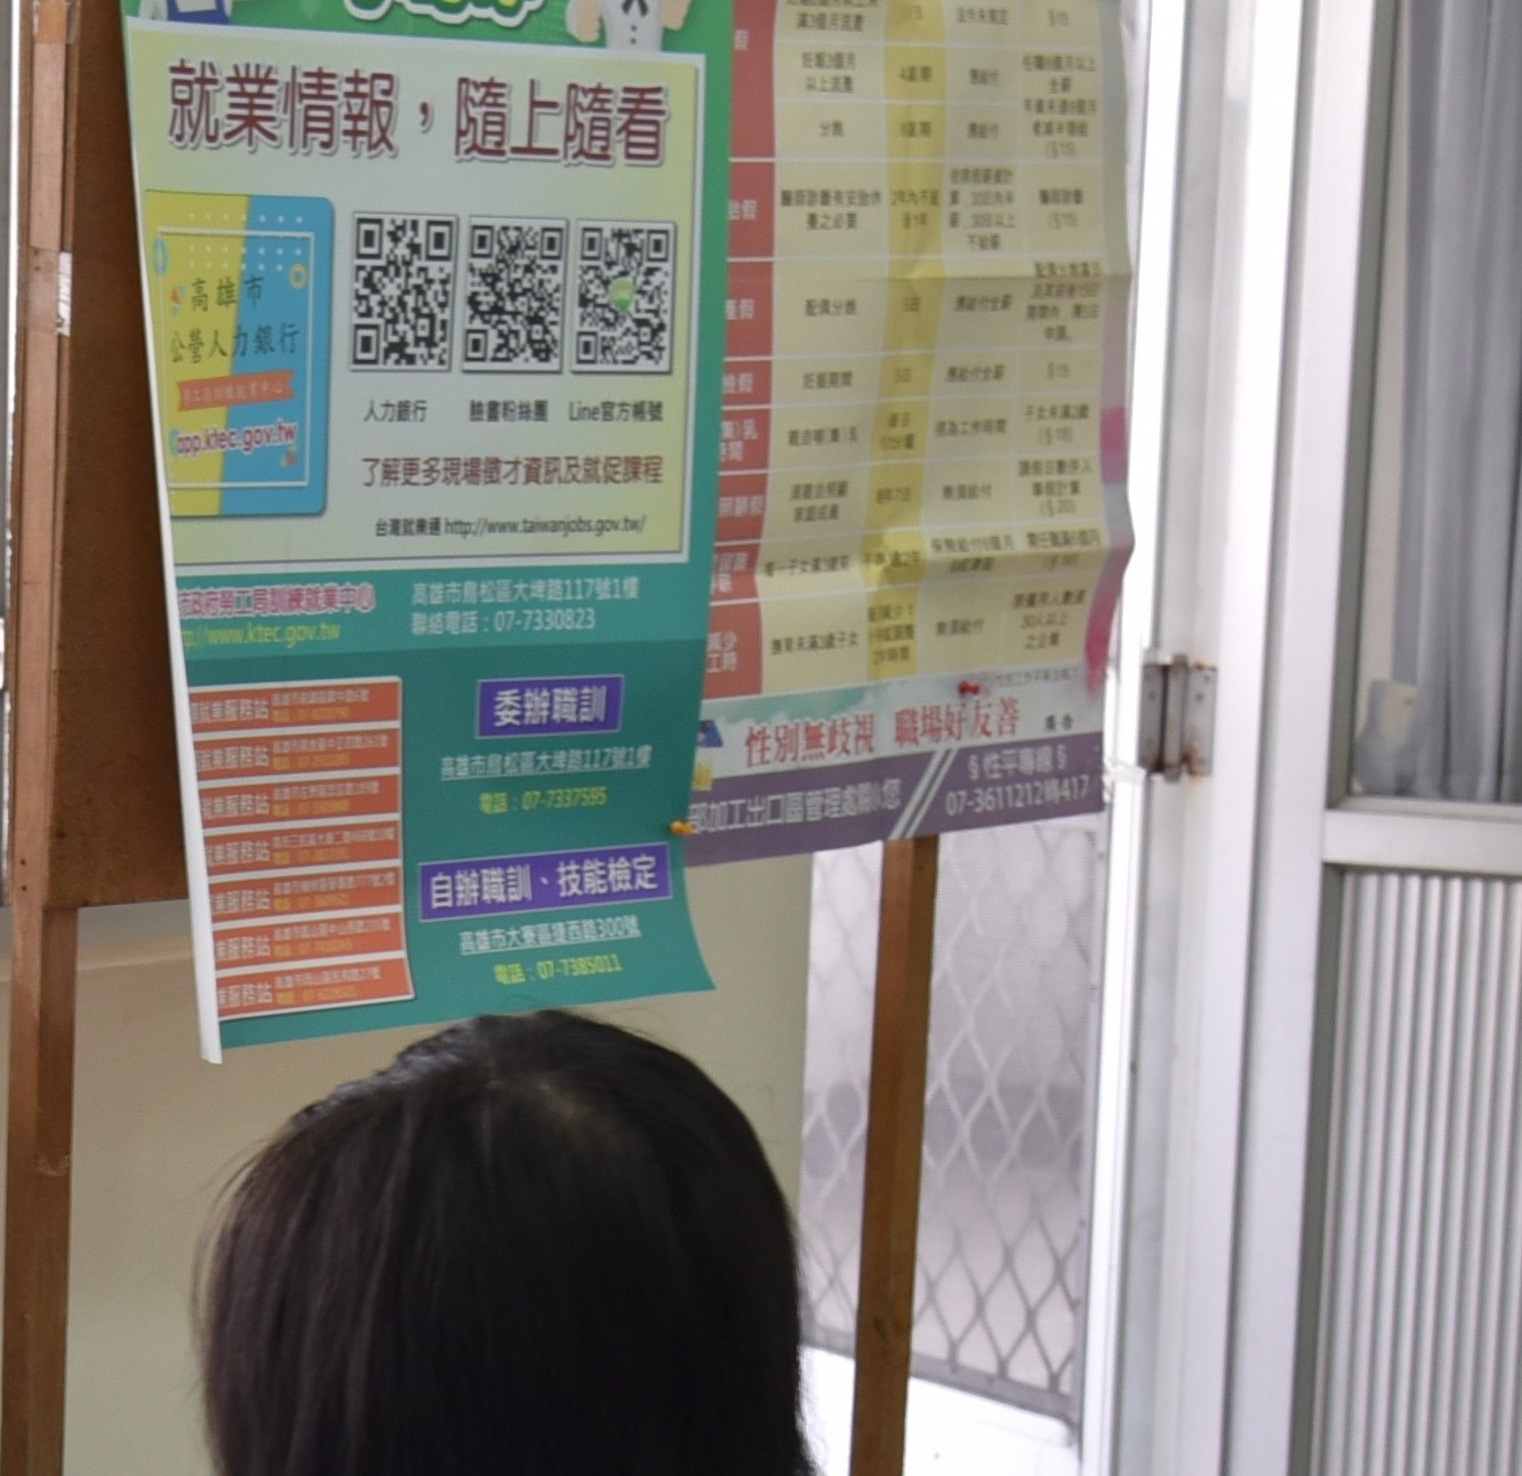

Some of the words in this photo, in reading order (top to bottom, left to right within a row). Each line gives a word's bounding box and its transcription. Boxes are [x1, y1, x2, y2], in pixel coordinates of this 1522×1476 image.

[168, 56, 667, 166] 就業情報，隨上隨看
[191, 273, 264, 314] 高雄市
[363, 399, 427, 423] 人力銀行
[493, 684, 608, 728] 委辦職訓
[744, 712, 876, 769] 性別無歧視
[893, 696, 1022, 748] 職場好友善
[430, 854, 659, 910] 自辦職訓、技能檢定
